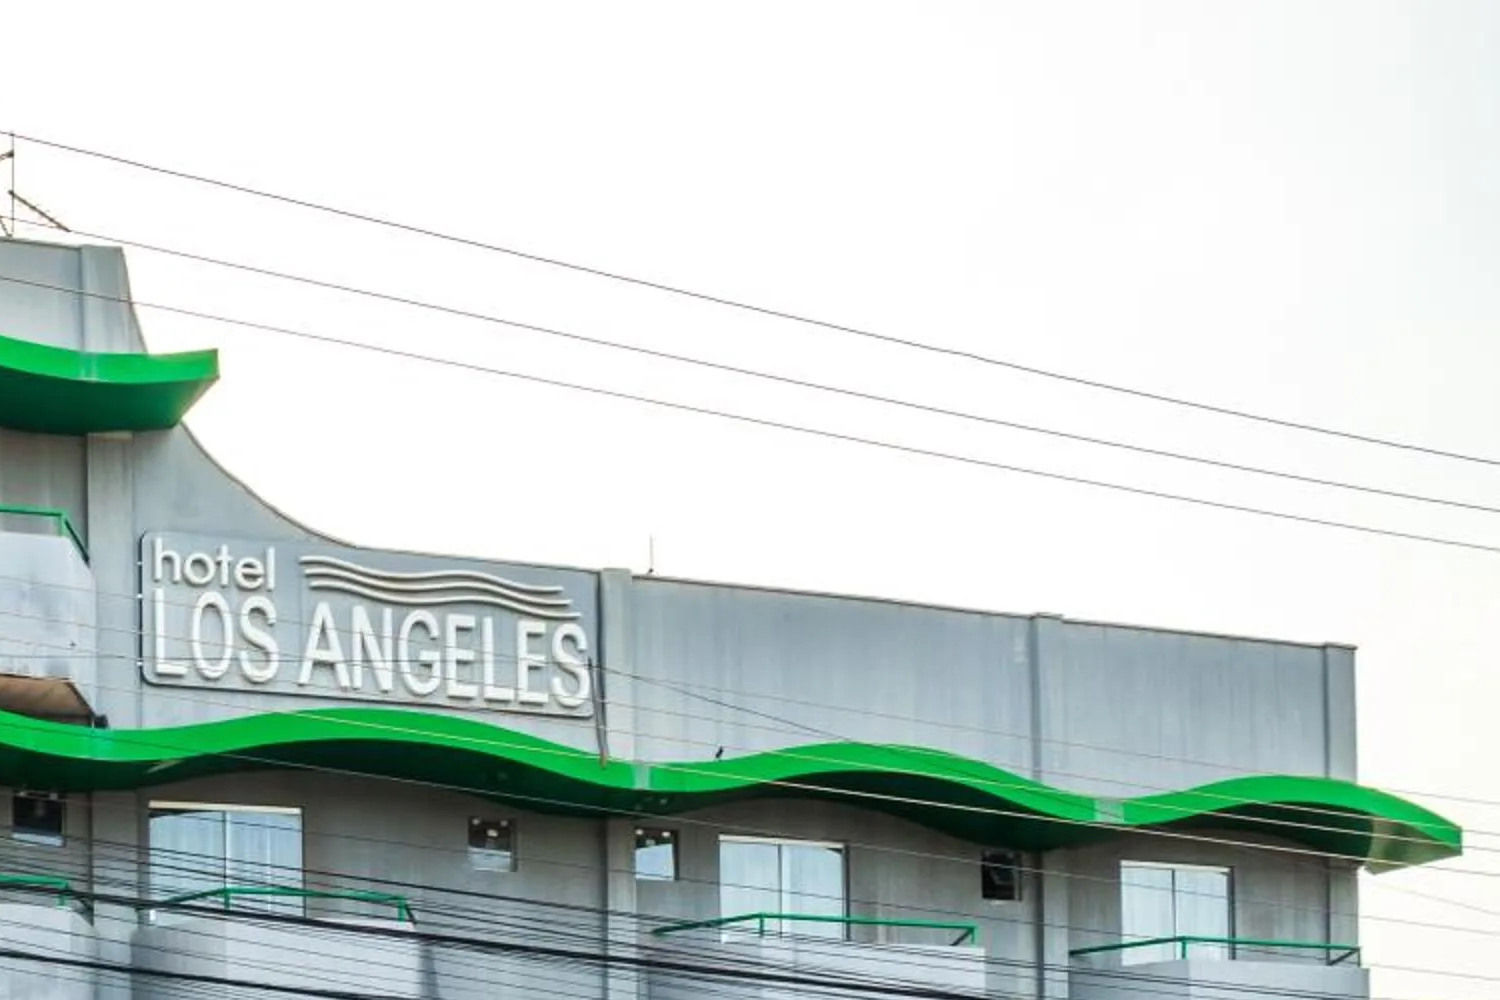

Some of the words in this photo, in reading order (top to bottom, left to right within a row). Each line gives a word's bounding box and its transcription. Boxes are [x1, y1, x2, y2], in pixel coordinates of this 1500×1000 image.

[152, 537, 277, 591] hotel
[154, 589, 280, 684] LOS
[297, 601, 590, 708] ANGELES
